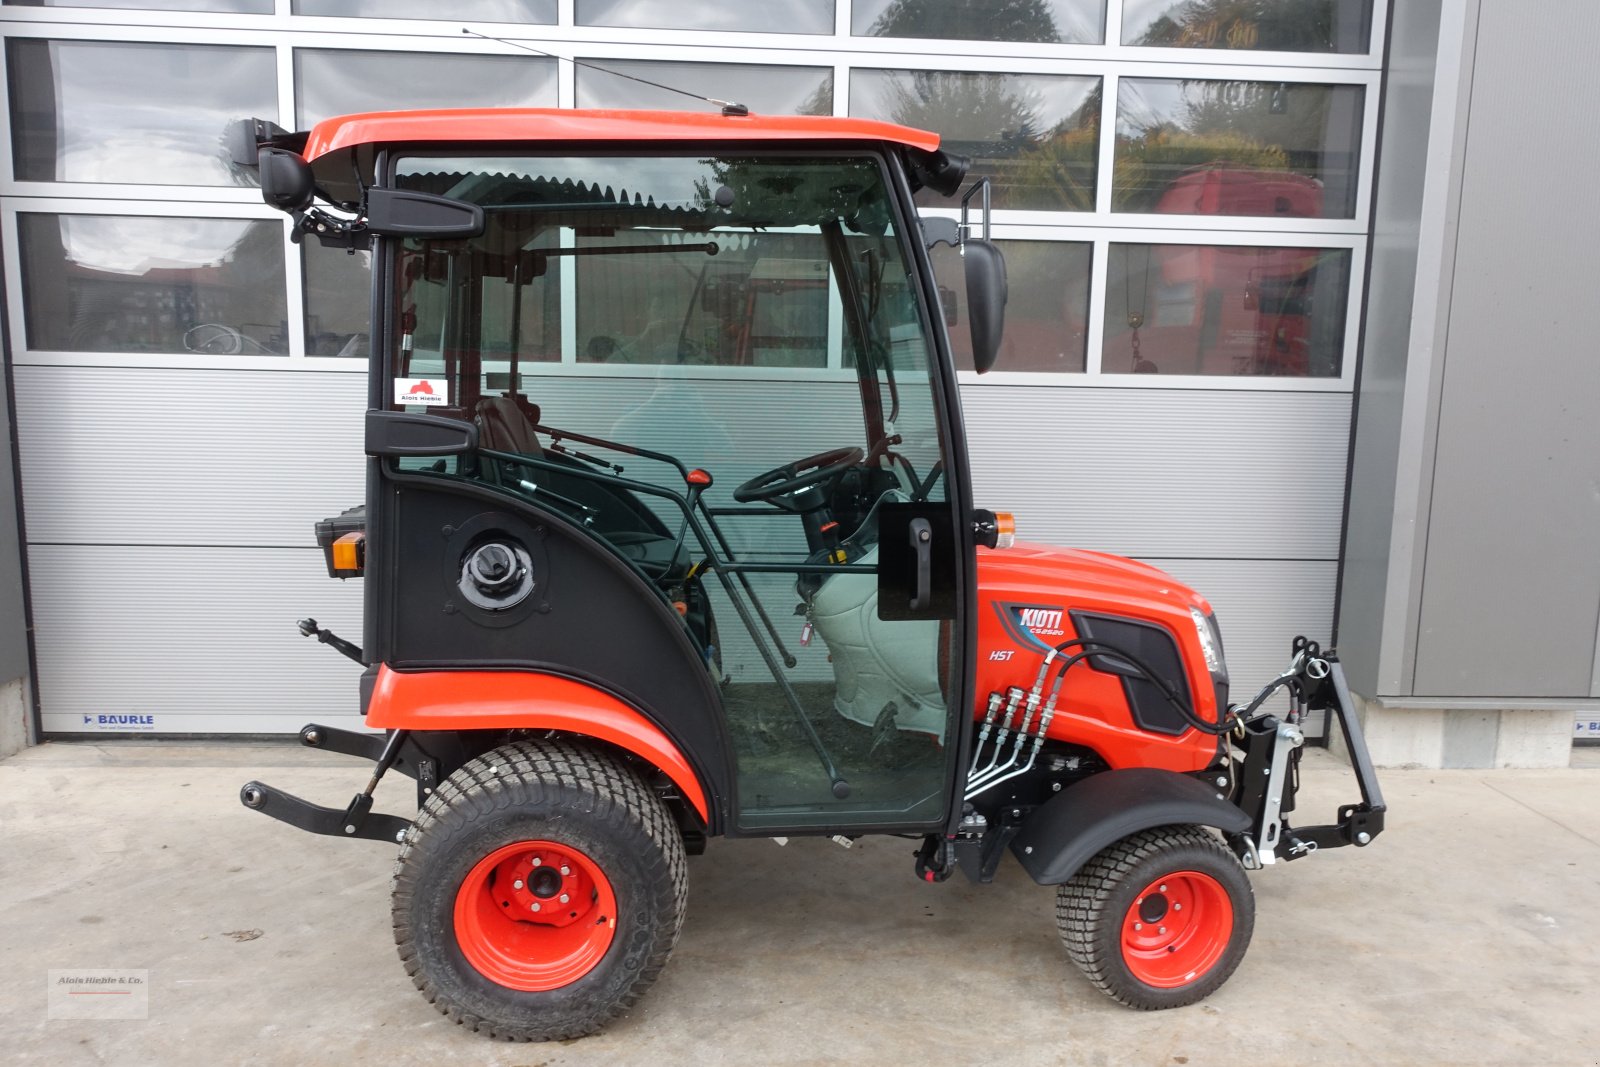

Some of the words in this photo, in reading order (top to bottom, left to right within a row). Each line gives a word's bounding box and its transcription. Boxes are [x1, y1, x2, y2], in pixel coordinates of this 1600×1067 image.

[1020, 608, 1063, 629] KIOTI
[1029, 628, 1065, 636] CS2520
[989, 650, 1015, 661] HST
